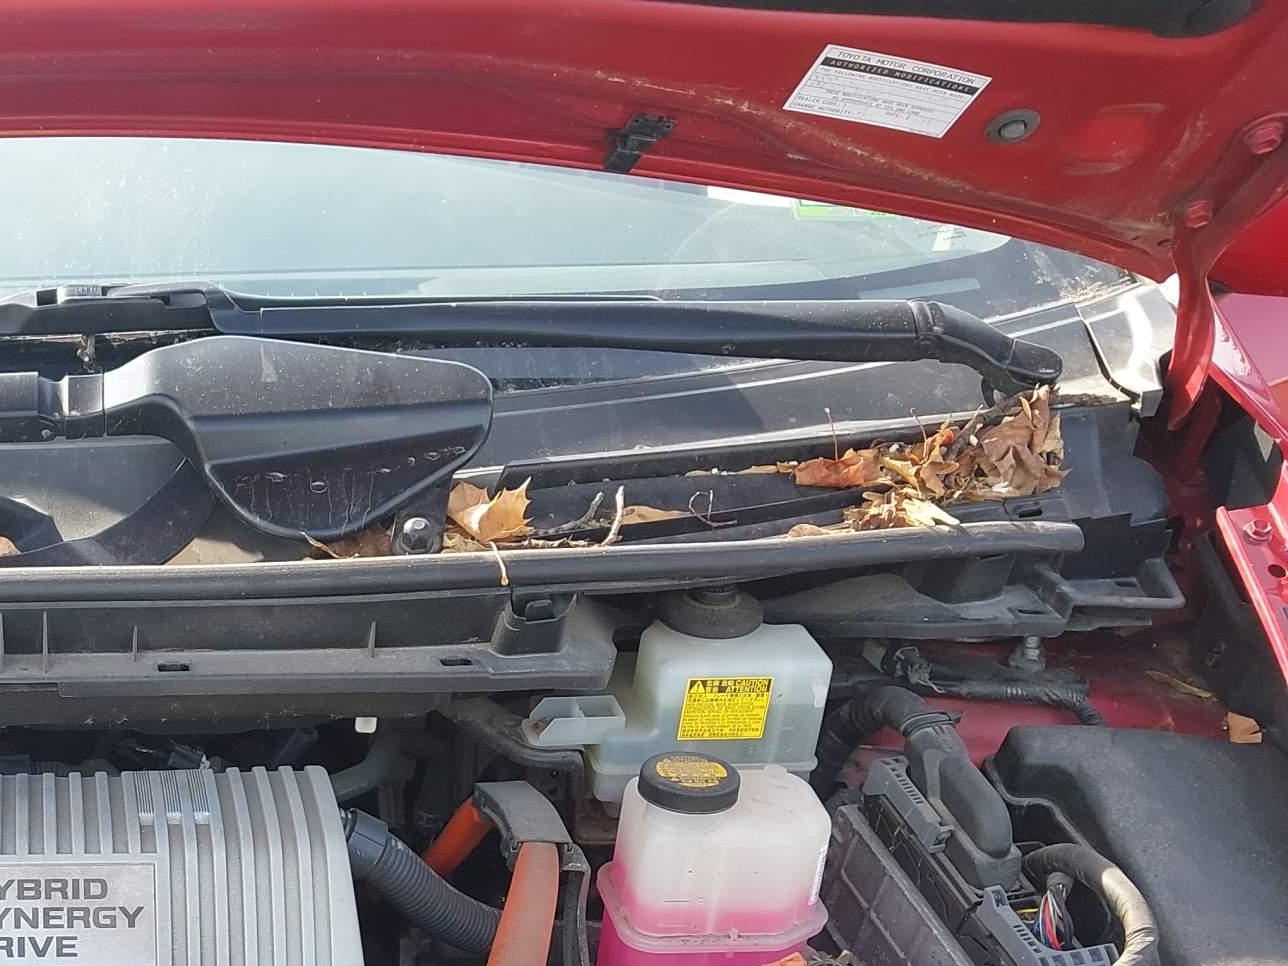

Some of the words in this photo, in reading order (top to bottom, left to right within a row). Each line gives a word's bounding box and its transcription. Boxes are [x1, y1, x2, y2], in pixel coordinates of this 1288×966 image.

[829, 59, 888, 75] AUTHORIZED
[893, 72, 971, 92] MODIFICATIONS
[836, 49, 873, 62] TOYOTA
[875, 58, 907, 69] MOTOR
[909, 65, 976, 84] CORPORATION
[725, 685, 768, 693] ATTENTION
[735, 679, 769, 687] CAUTION
